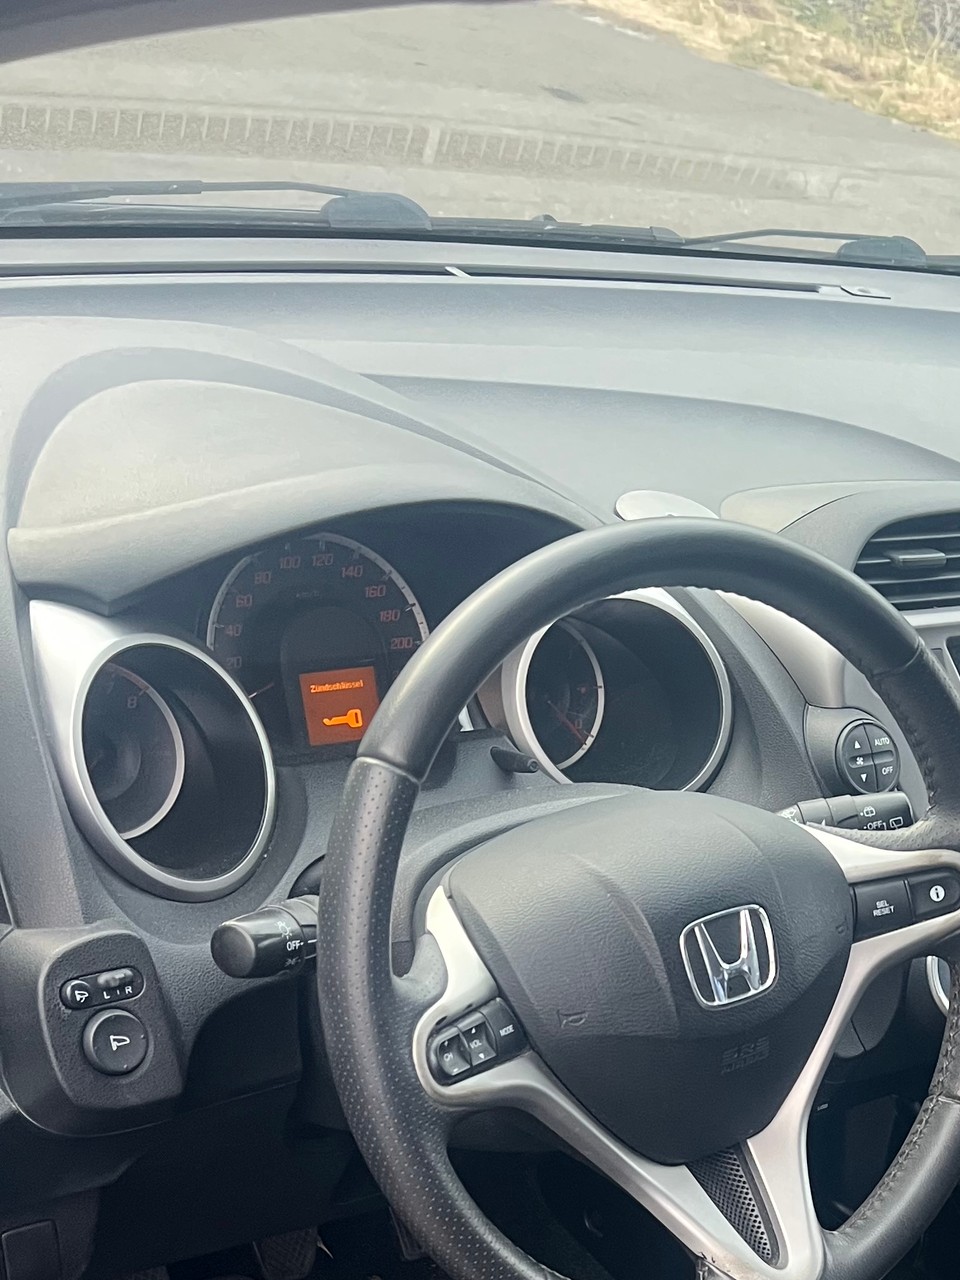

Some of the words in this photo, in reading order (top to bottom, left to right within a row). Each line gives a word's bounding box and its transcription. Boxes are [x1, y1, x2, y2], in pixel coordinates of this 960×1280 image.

[279, 555, 300, 569] 100
[312, 553, 333, 566] 120
[341, 564, 363, 578] 140
[254, 571, 271, 585] 80
[364, 585, 386, 598] 160
[236, 594, 252, 608] 60
[379, 608, 400, 622] 180
[225, 624, 241, 637] 40
[390, 636, 412, 649] 200
[225, 656, 242, 670] 20
[127, 697, 137, 709] 8
[874, 737, 890, 746] AUTO
[881, 765, 894, 776] OFF
[867, 820, 882, 831] OFF
[875, 899, 890, 909] SEL
[872, 905, 895, 917] RESET
[286, 941, 301, 951] OFF
[103, 990, 110, 1000] L
[125, 985, 133, 995] R
[469, 1039, 482, 1049] VOL
